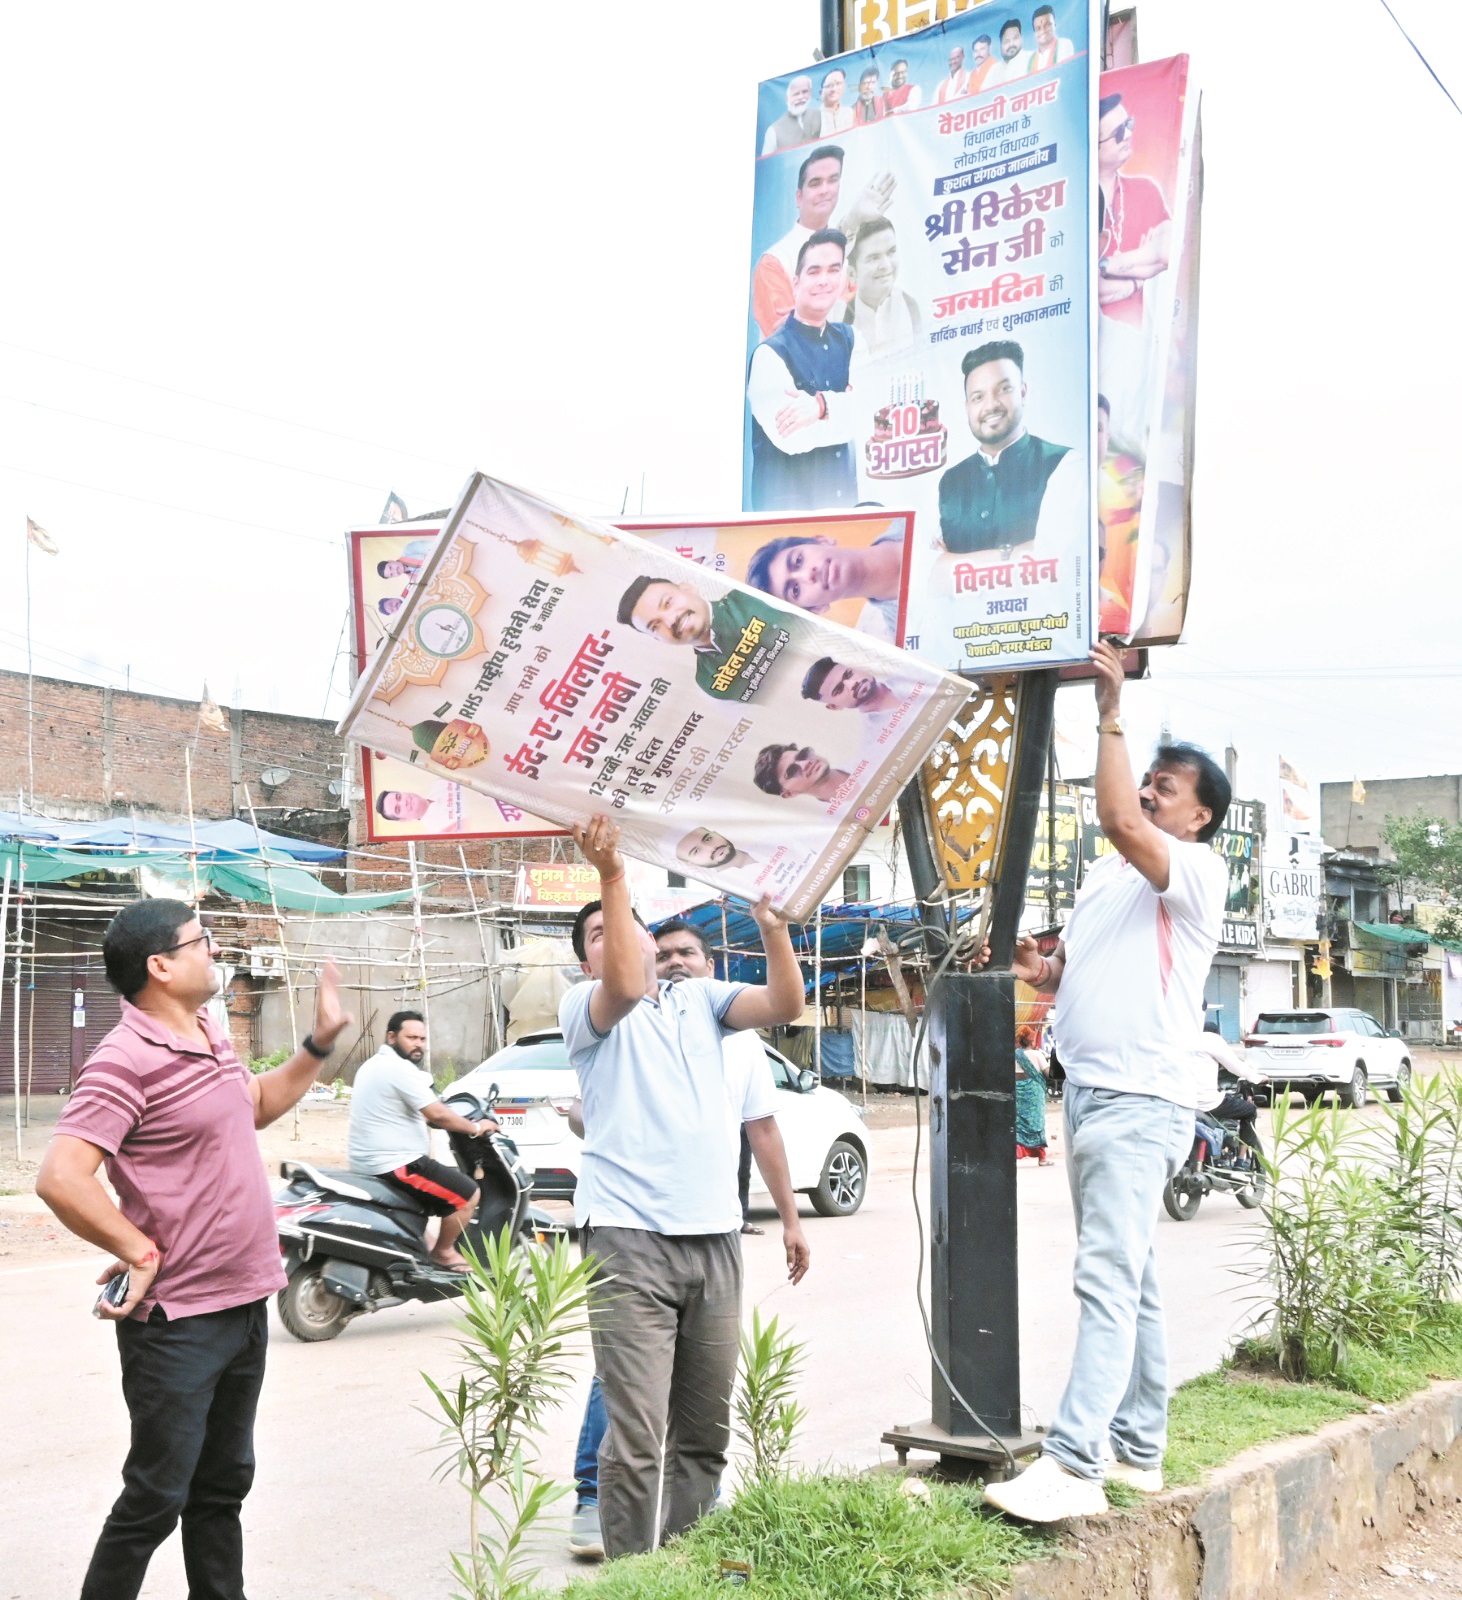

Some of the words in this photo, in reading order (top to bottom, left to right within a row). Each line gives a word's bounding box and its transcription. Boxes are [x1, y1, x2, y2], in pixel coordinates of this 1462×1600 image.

[938, 96, 1006, 135] वैशाली
[1010, 80, 1058, 112] नगर
[954, 145, 997, 169] लोकप्रिय
[1000, 132, 1040, 156] विधायक
[964, 120, 1018, 148] विधानसभा
[1021, 115, 1031, 129] के
[943, 174, 972, 195] कुशल
[973, 163, 1007, 185] संगठक
[1008, 149, 1050, 173] माननीय
[925, 199, 967, 242] श्री
[971, 182, 1066, 231] रिकेश
[941, 237, 999, 275] सेन
[1004, 218, 1046, 262] जी
[1050, 231, 1065, 248] को
[932, 272, 1045, 319] जन्मदिन
[1049, 274, 1065, 291] की
[930, 325, 957, 343] हार्दिक
[960, 319, 983, 336] बधाई
[986, 318, 1000, 331] एवं
[1002, 298, 1072, 332] शुभकामनाएं
[891, 406, 918, 437] 10
[871, 435, 941, 471] अगस्त
[715, 553, 726, 572] 790
[953, 563, 1014, 593] विनय
[1018, 555, 1059, 585] सेन
[529, 622, 543, 632] के
[537, 595, 559, 622] जानिब
[550, 586, 565, 595] से
[986, 597, 1028, 615] अध्यक्ष
[954, 623, 989, 639] भारतीय
[990, 620, 1020, 635] जनता
[1020, 618, 1041, 634] युवा
[1042, 612, 1068, 629] मोर्चा
[457, 692, 483, 719] RHS
[473, 649, 509, 692] राष्ट्रीय
[498, 609, 533, 653] हुसैनी
[518, 578, 549, 609] सेना
[710, 652, 745, 691] सोहेल
[734, 616, 765, 654] राईन
[966, 641, 1000, 657] वैशाली
[1002, 643, 1024, 654] नगर
[1025, 637, 1052, 651] मंडल
[503, 691, 524, 715] आप
[516, 664, 540, 689] सभी
[533, 644, 552, 663] को
[561, 670, 642, 769] उन-नबी
[588, 780, 607, 796] 12
[649, 676, 671, 696] की
[634, 736, 664, 765] दिल
[639, 781, 657, 795] से
[650, 710, 704, 778] मुबारकबाद
[689, 762, 724, 803] आमद
[713, 716, 753, 763] मरहबा
[623, 765, 646, 787] तहे
[655, 766, 697, 815] सरकार
[688, 745, 710, 766] की
[609, 787, 630, 809] की
[1221, 833, 1251, 858] KIDS
[529, 868, 565, 886] शुभम
[567, 865, 601, 883] रेडिमे
[791, 893, 810, 915] JOIN
[805, 849, 841, 894] HUSSAINI
[836, 820, 863, 850] SENA
[1270, 870, 1317, 898] GABRU
[1235, 925, 1256, 945] KIDS
[507, 1116, 523, 1126] 7300
